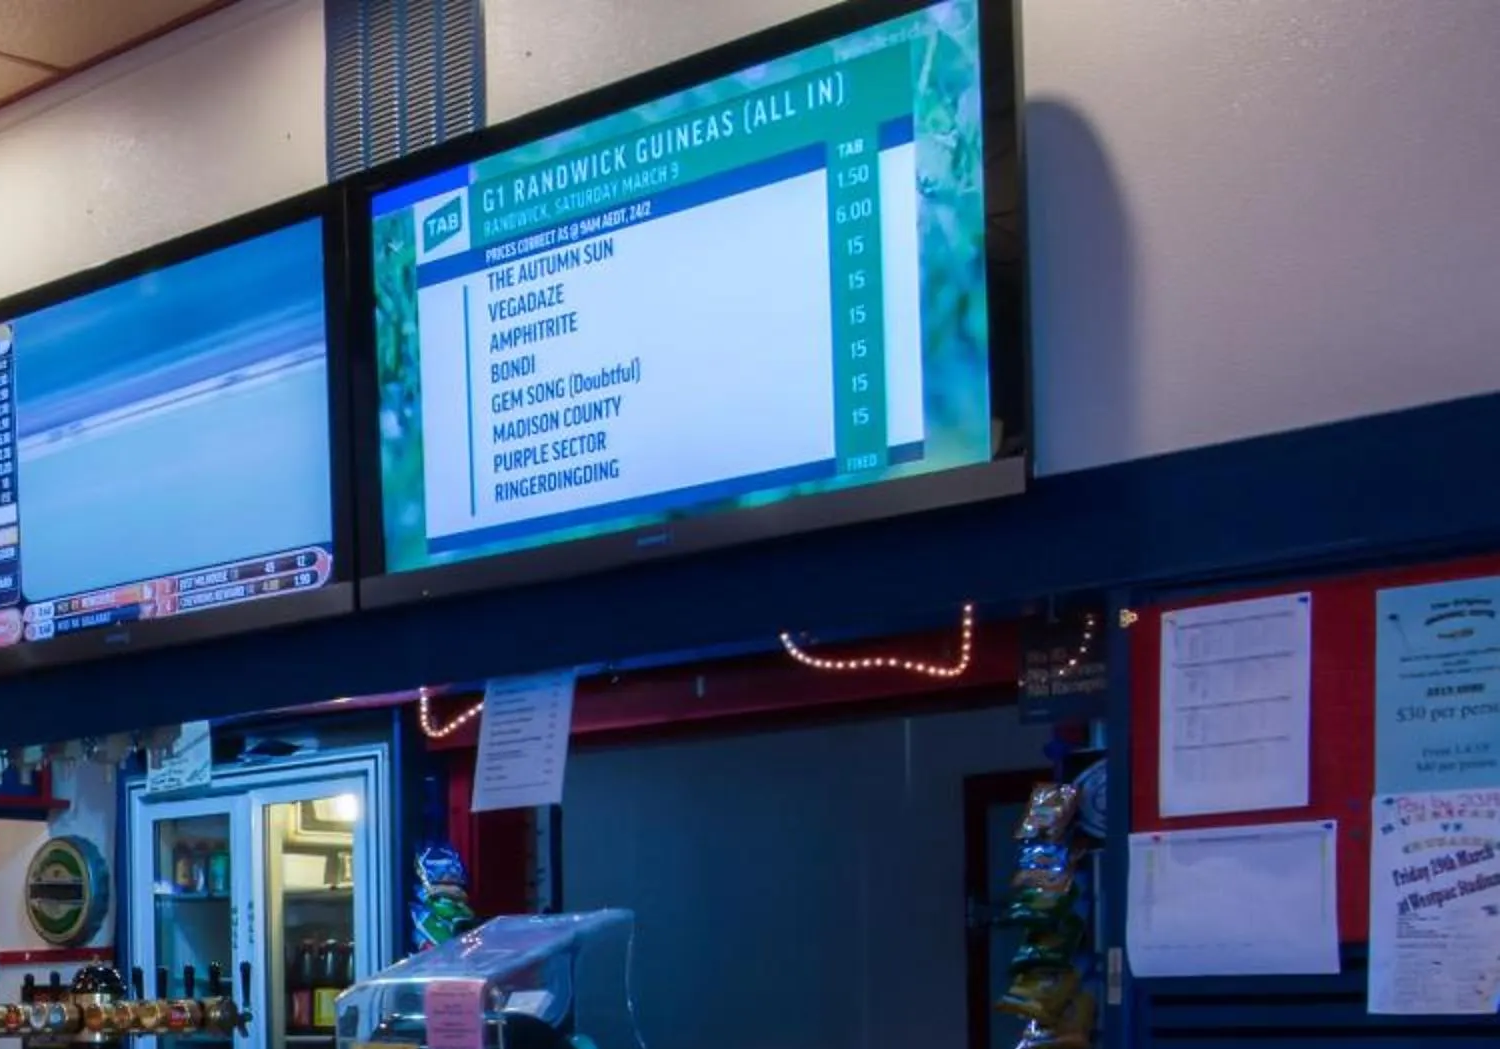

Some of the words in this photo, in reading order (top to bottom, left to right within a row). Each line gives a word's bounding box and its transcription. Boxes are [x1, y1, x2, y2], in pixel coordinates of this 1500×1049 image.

[483, 185, 505, 213] G1
[514, 145, 626, 203] RANDWICK
[635, 110, 734, 164] GUINEAS
[743, 95, 796, 135] (ALL
[807, 71, 845, 111] IN)
[836, 138, 863, 159] TAB
[837, 164, 869, 189] 1.50
[555, 184, 620, 217] SATURDAY
[622, 166, 668, 194] MARCH
[836, 198, 872, 224] 6.00
[427, 212, 459, 237] TAB
[485, 242, 517, 264] PRICES
[847, 235, 865, 256] 15
[487, 266, 515, 293] THE
[517, 246, 581, 285] AUTUMN
[583, 237, 614, 265] SUN
[848, 270, 866, 291] 15
[488, 283, 565, 323] VEGADAZE
[849, 304, 866, 325] 15
[489, 311, 579, 355] AMPHITRITE
[851, 339, 867, 360] 15
[491, 354, 536, 384] BONDI
[491, 388, 524, 414] GEM
[526, 377, 566, 406] SONG
[569, 356, 641, 398] (Doubtful)
[852, 373, 868, 394] 15
[492, 409, 560, 445] MADISON
[563, 394, 622, 427] COUNTY
[852, 407, 870, 427] 15
[493, 443, 549, 474] PURPLE
[551, 431, 607, 461] SECTOR
[494, 458, 620, 503] RINGERDINGDING
[1430, 706, 1456, 723] per
